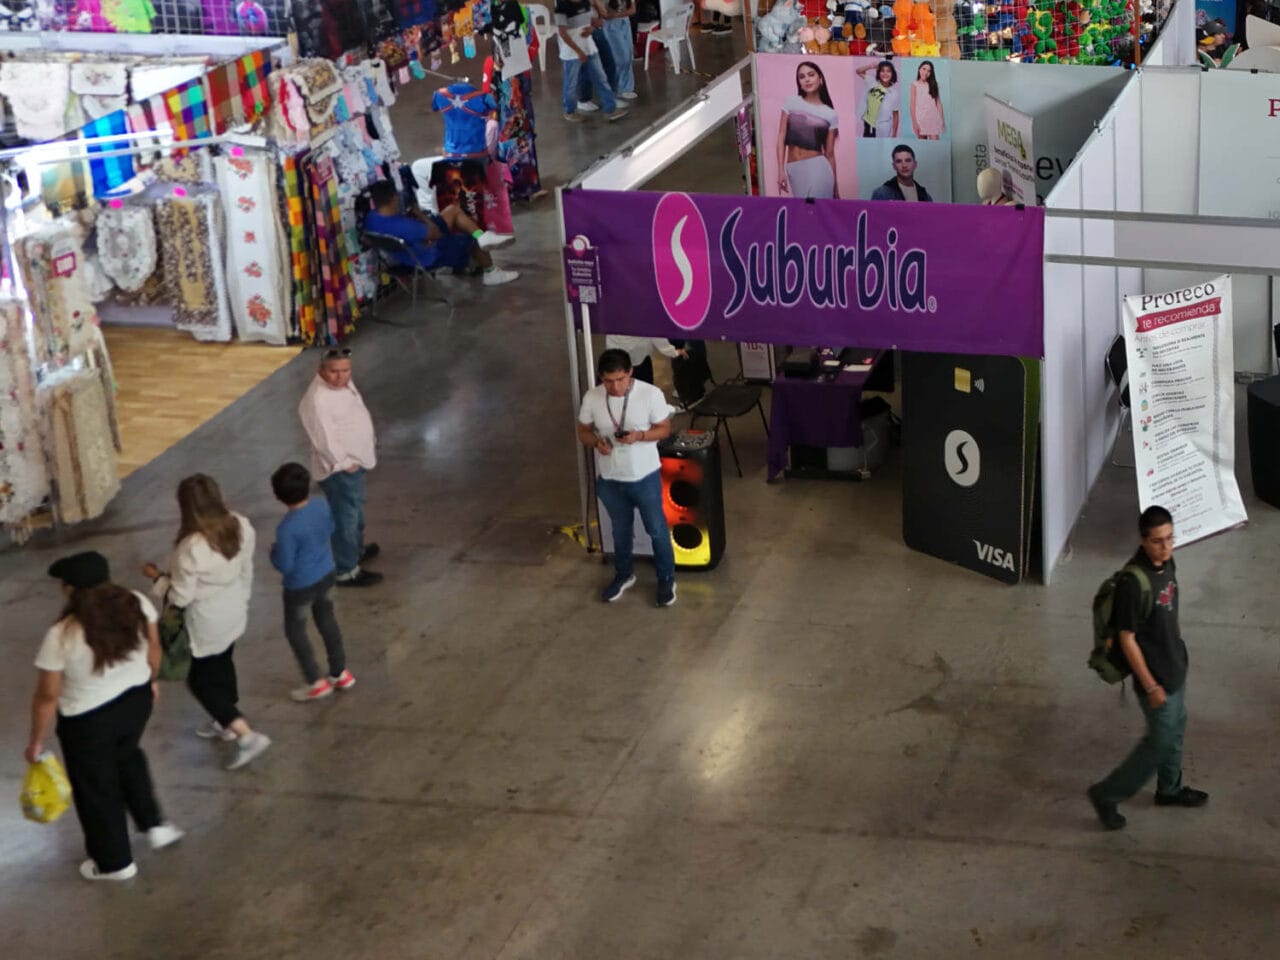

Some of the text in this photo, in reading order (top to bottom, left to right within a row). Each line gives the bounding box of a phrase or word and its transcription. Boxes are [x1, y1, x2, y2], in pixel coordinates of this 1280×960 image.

[997, 119, 1025, 152] MEGA
[720, 206, 928, 319] Suburbia
[1142, 302, 1216, 329] te recomienda
[972, 538, 1016, 572] VISA
